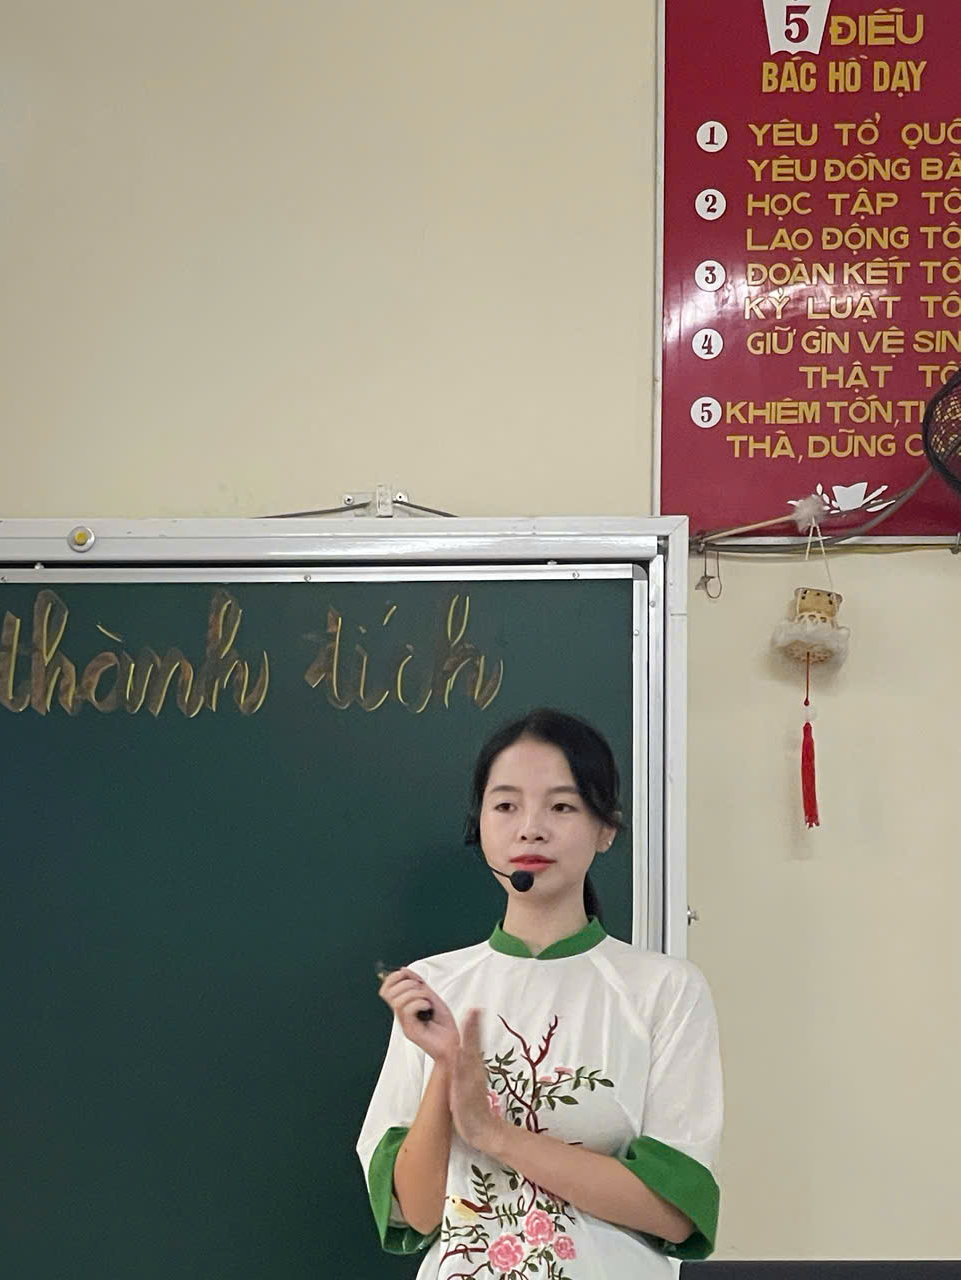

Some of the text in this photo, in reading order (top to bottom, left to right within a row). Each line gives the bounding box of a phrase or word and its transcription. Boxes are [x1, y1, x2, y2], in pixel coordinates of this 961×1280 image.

[784, 5, 924, 46] 5 ĐIỀU
[762, 55, 927, 98] BÁC HỒ DẠY
[704, 126, 719, 146] 1
[748, 118, 818, 146] YÊU
[834, 112, 881, 146] TỔ
[747, 154, 817, 182] YÊU
[824, 152, 911, 182] ĐỒNG
[704, 194, 717, 213] 2
[747, 192, 813, 222] HỌC
[828, 187, 899, 220] TẬP
[746, 227, 814, 251] LAO
[821, 222, 910, 256] ĐỘNG
[704, 266, 717, 285] 3
[747, 256, 835, 287] ĐOÀN
[843, 255, 911, 285] KẾT
[744, 288, 791, 320] KỶ
[807, 292, 902, 323] LUẬT
[701, 335, 714, 355] 4
[746, 325, 797, 355] GIỮ
[801, 325, 850, 354] GÌN
[859, 325, 905, 358] VỆ
[798, 360, 893, 393] THẬT
[700, 403, 713, 423] 5
[725, 397, 821, 425] KHIÊM
[725, 430, 804, 464] THÀ,
[807, 429, 896, 458] DŨNG
[303, 594, 504, 713] tích
